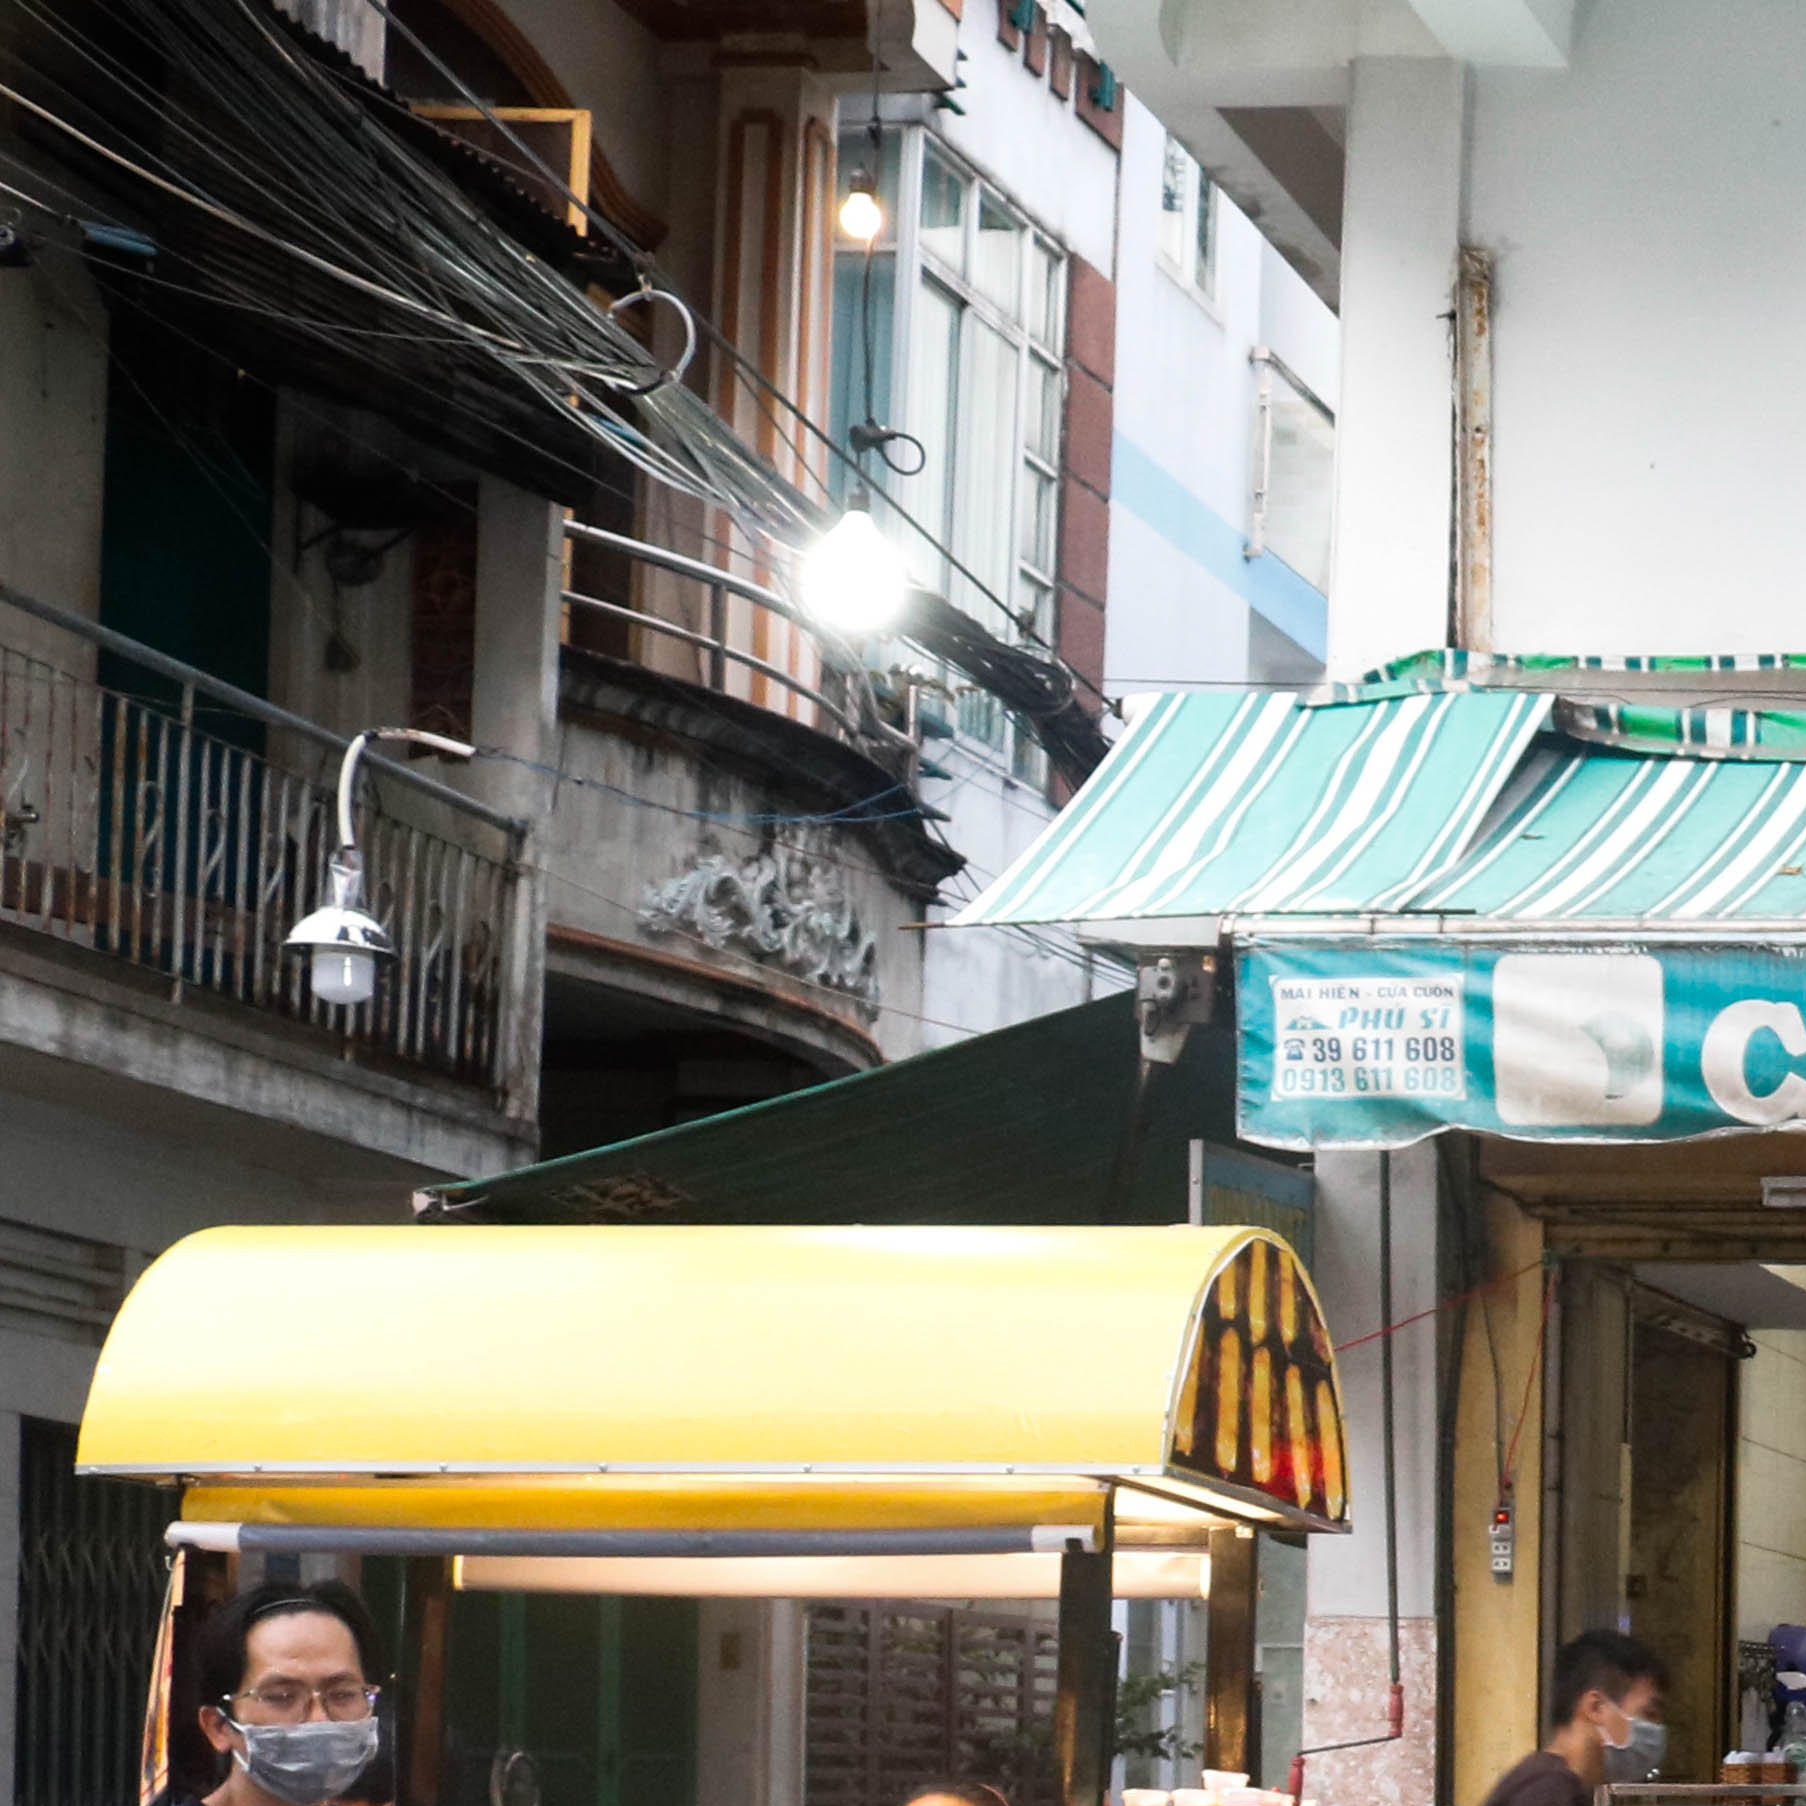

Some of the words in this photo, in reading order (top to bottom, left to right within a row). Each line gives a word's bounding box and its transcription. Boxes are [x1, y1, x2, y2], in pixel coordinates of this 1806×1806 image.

[1312, 1037, 1342, 1062] 39
[1352, 1038, 1394, 1061] 611
[1405, 1036, 1455, 1062] 608
[1283, 1067, 1345, 1092] 0913
[1355, 1067, 1393, 1092] 611
[1404, 1067, 1456, 1092] 608
